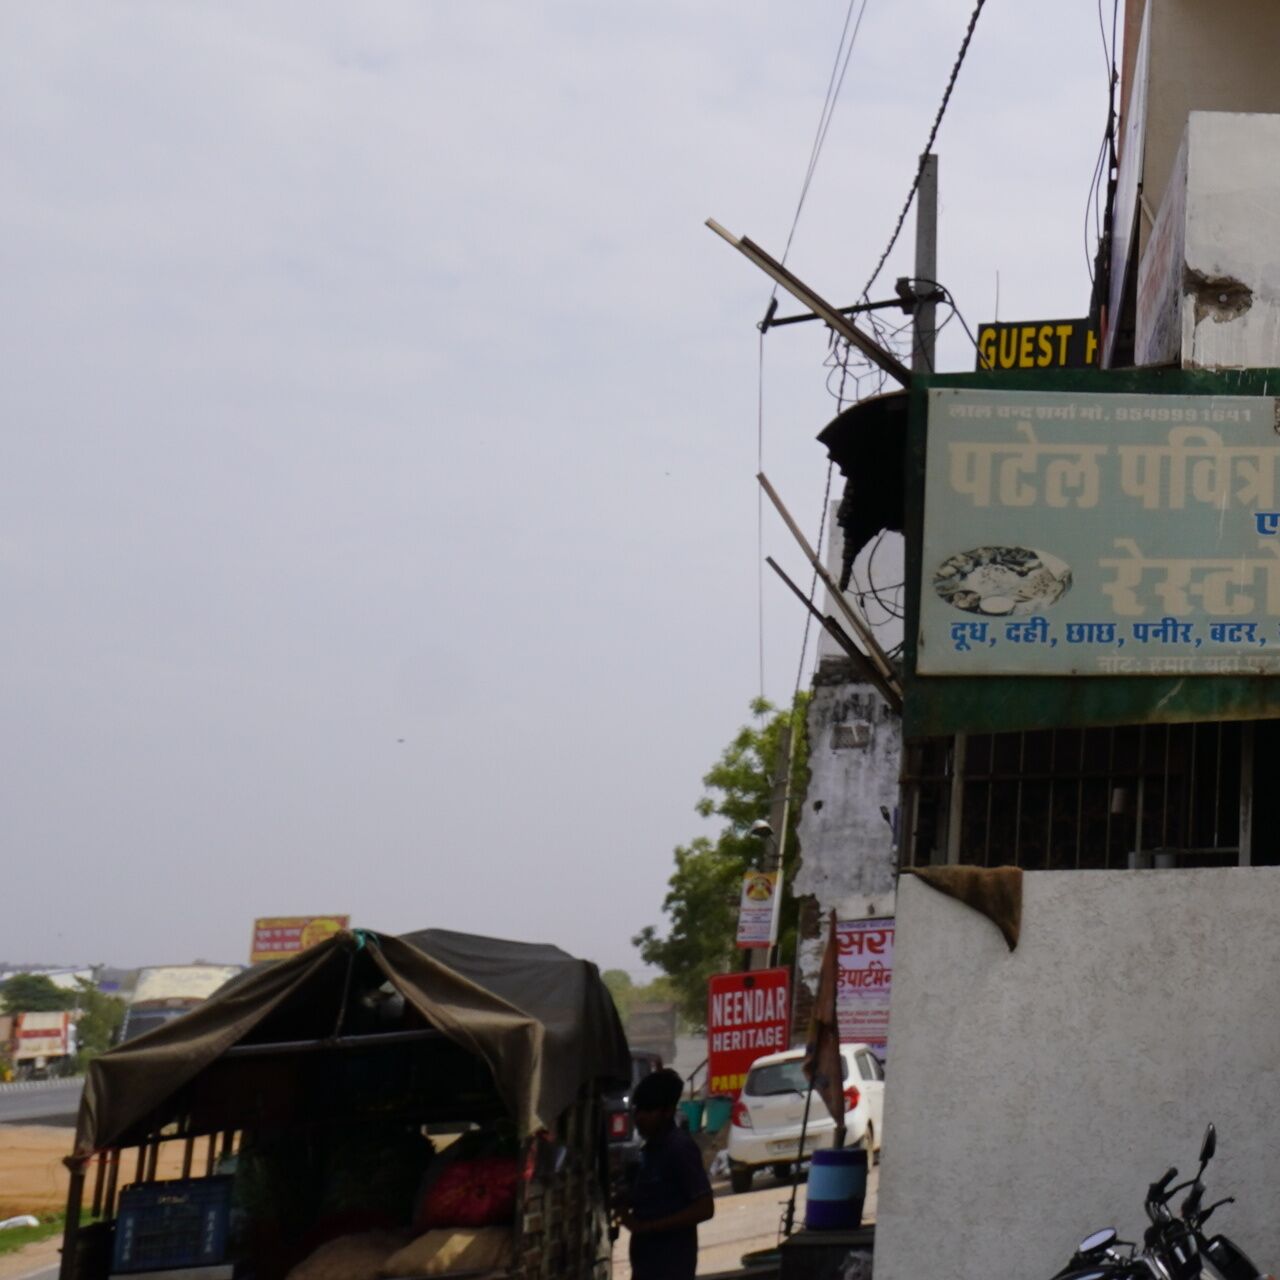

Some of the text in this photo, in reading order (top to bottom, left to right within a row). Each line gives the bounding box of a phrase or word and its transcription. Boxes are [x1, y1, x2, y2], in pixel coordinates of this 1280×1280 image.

[978, 324, 1073, 369] GUEST
[949, 421, 1108, 508] पटेल
[711, 986, 786, 1027] NEENDAR
[711, 1025, 785, 1052] HERITAGE
